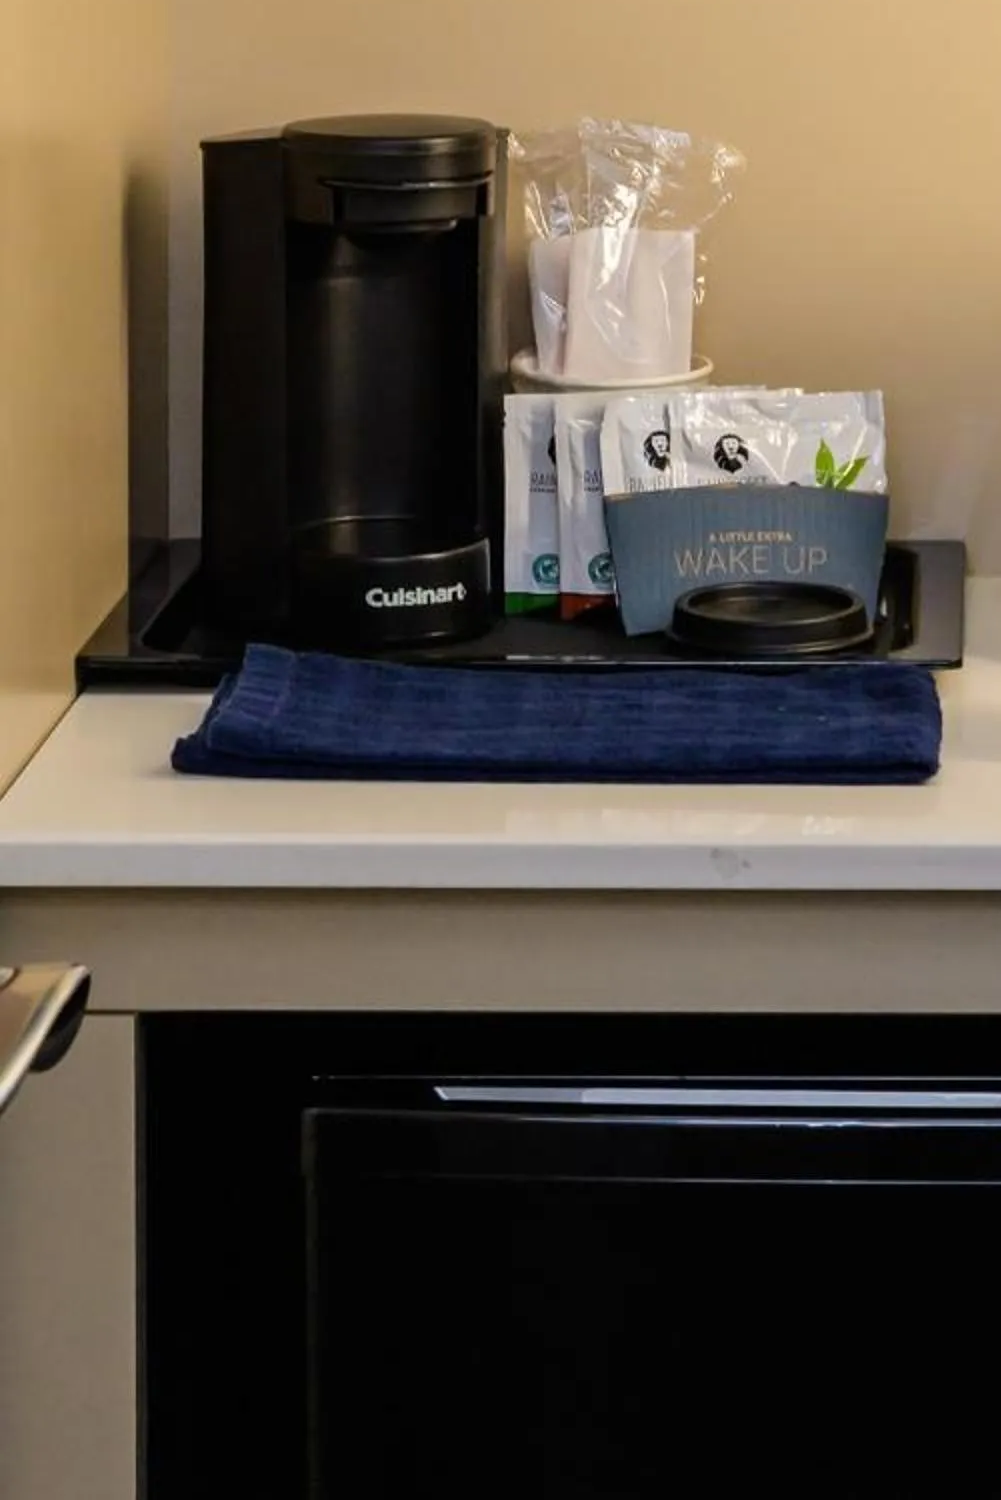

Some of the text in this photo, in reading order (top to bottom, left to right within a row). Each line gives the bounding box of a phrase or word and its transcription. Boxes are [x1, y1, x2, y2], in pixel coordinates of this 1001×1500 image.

[674, 545, 828, 577] WAKE UP
[365, 582, 465, 608] Cuisinart
